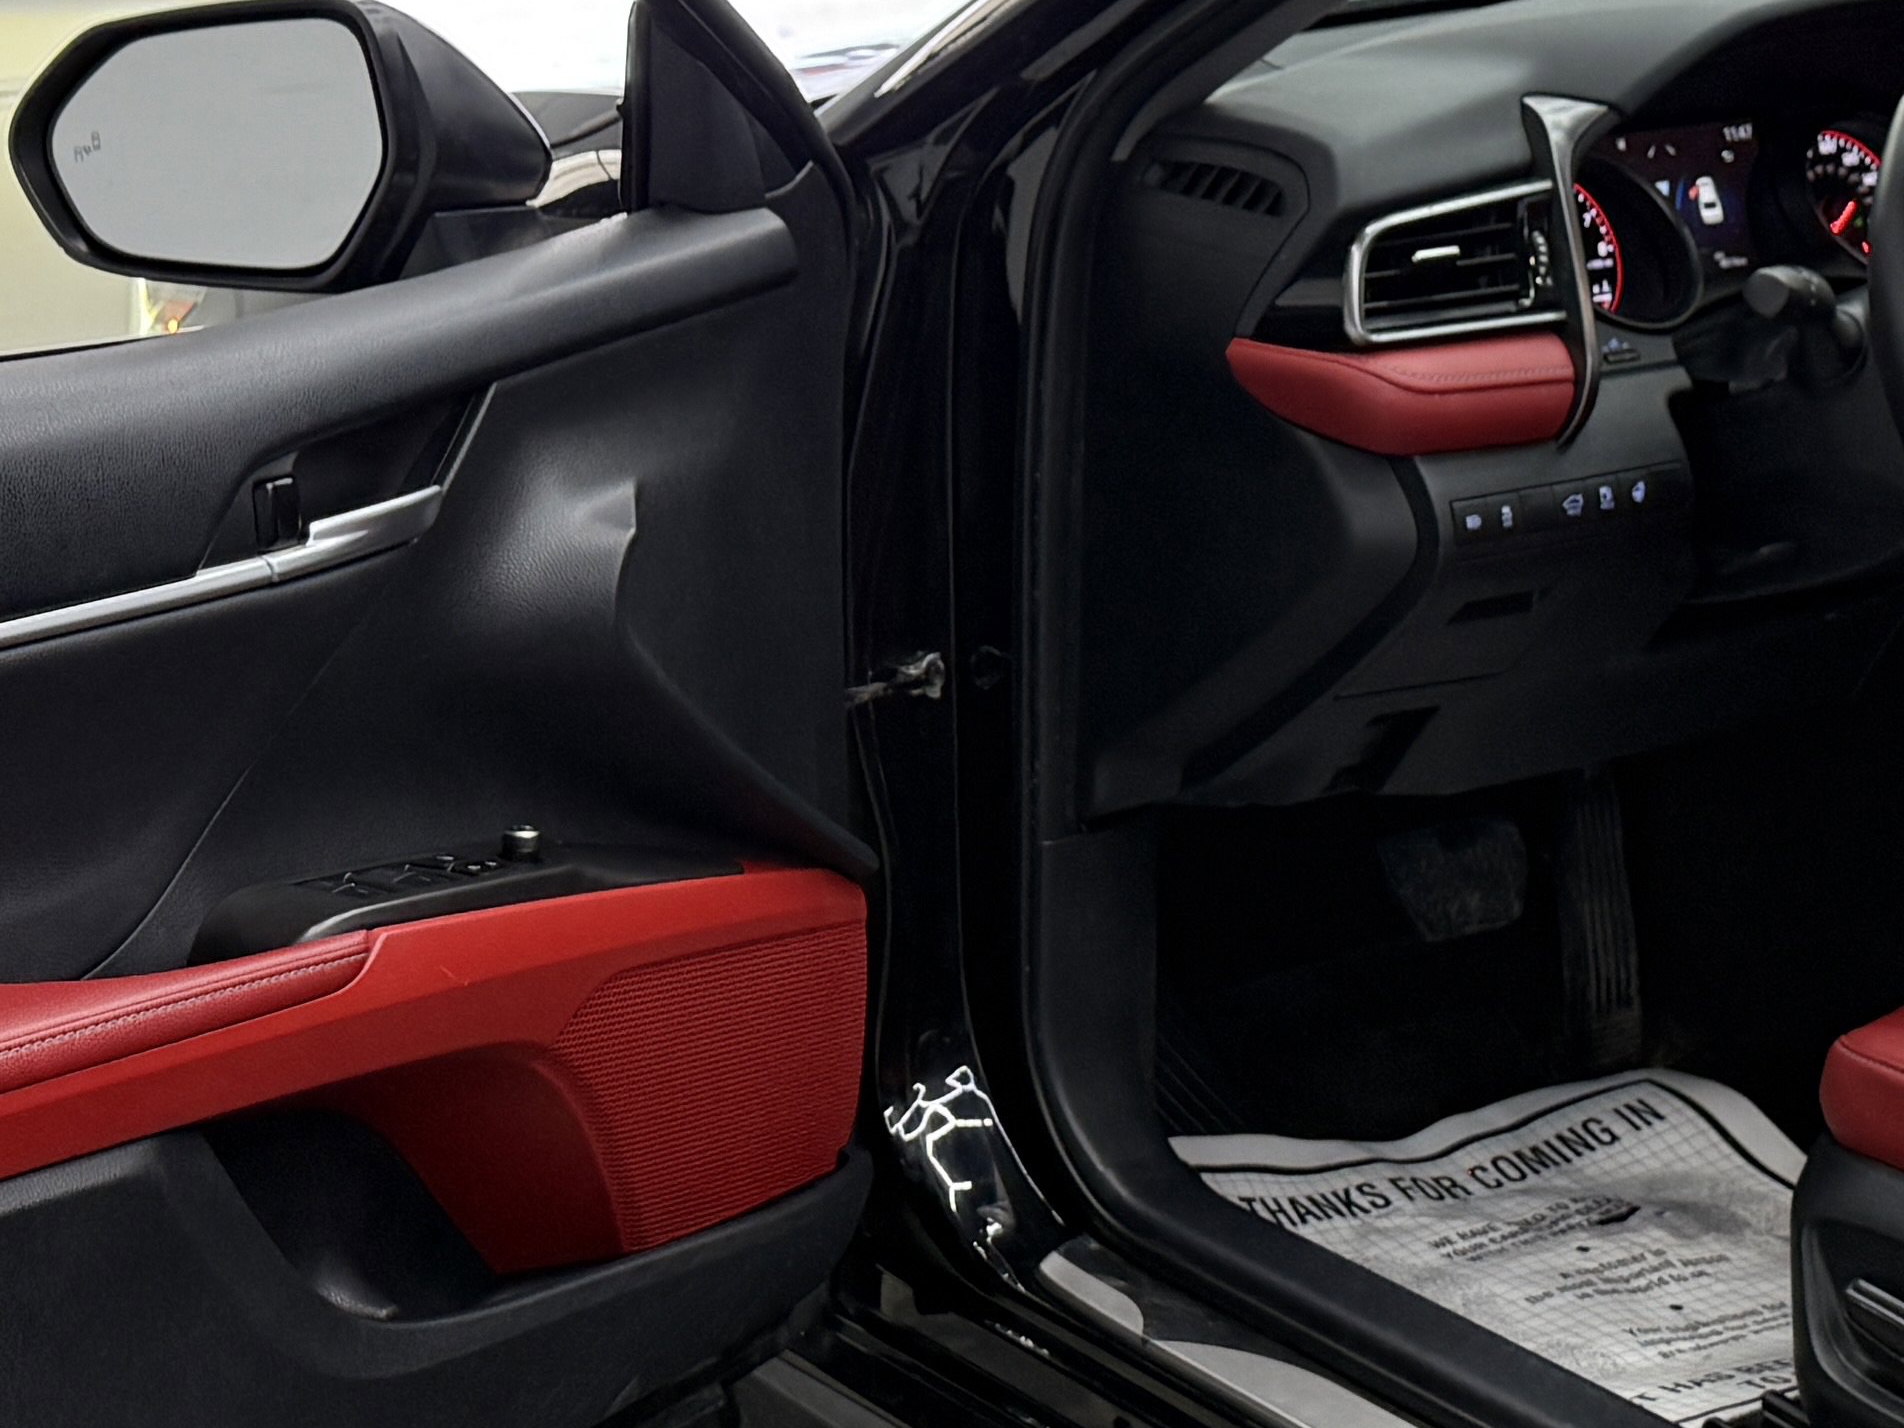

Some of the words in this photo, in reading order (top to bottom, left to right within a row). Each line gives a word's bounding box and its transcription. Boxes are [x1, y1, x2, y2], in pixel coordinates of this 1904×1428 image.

[1238, 1181, 1391, 1229] THANKS
[1388, 1172, 1469, 1204] FOR
[1467, 1119, 1620, 1190] COMING
[1619, 1098, 1666, 1134] IN
